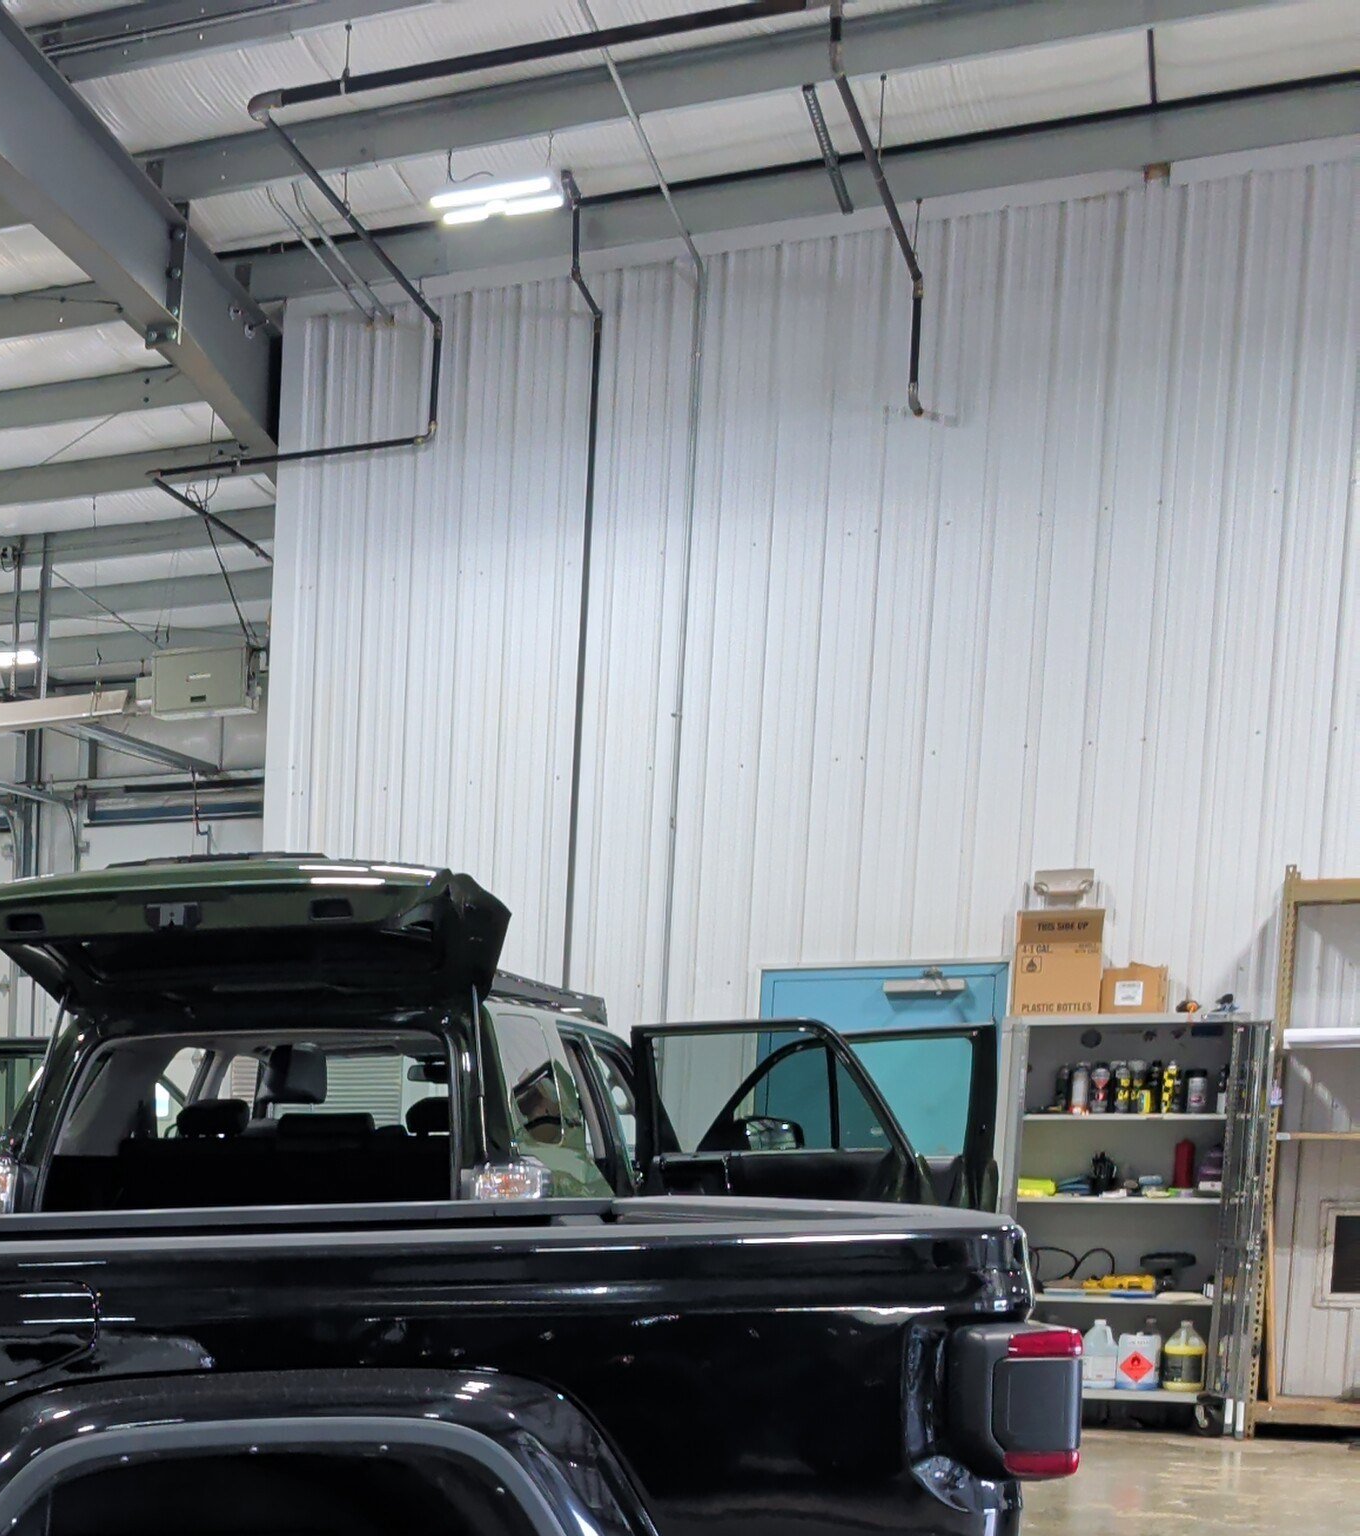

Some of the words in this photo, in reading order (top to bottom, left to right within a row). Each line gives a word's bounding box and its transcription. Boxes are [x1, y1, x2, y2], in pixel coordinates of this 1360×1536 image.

[1037, 921, 1055, 932] THIS
[1057, 921, 1075, 931] SIDE
[1077, 920, 1089, 930] UP
[1021, 1003, 1054, 1012] PLASTIC
[1057, 1002, 1092, 1011] BOTTLES
